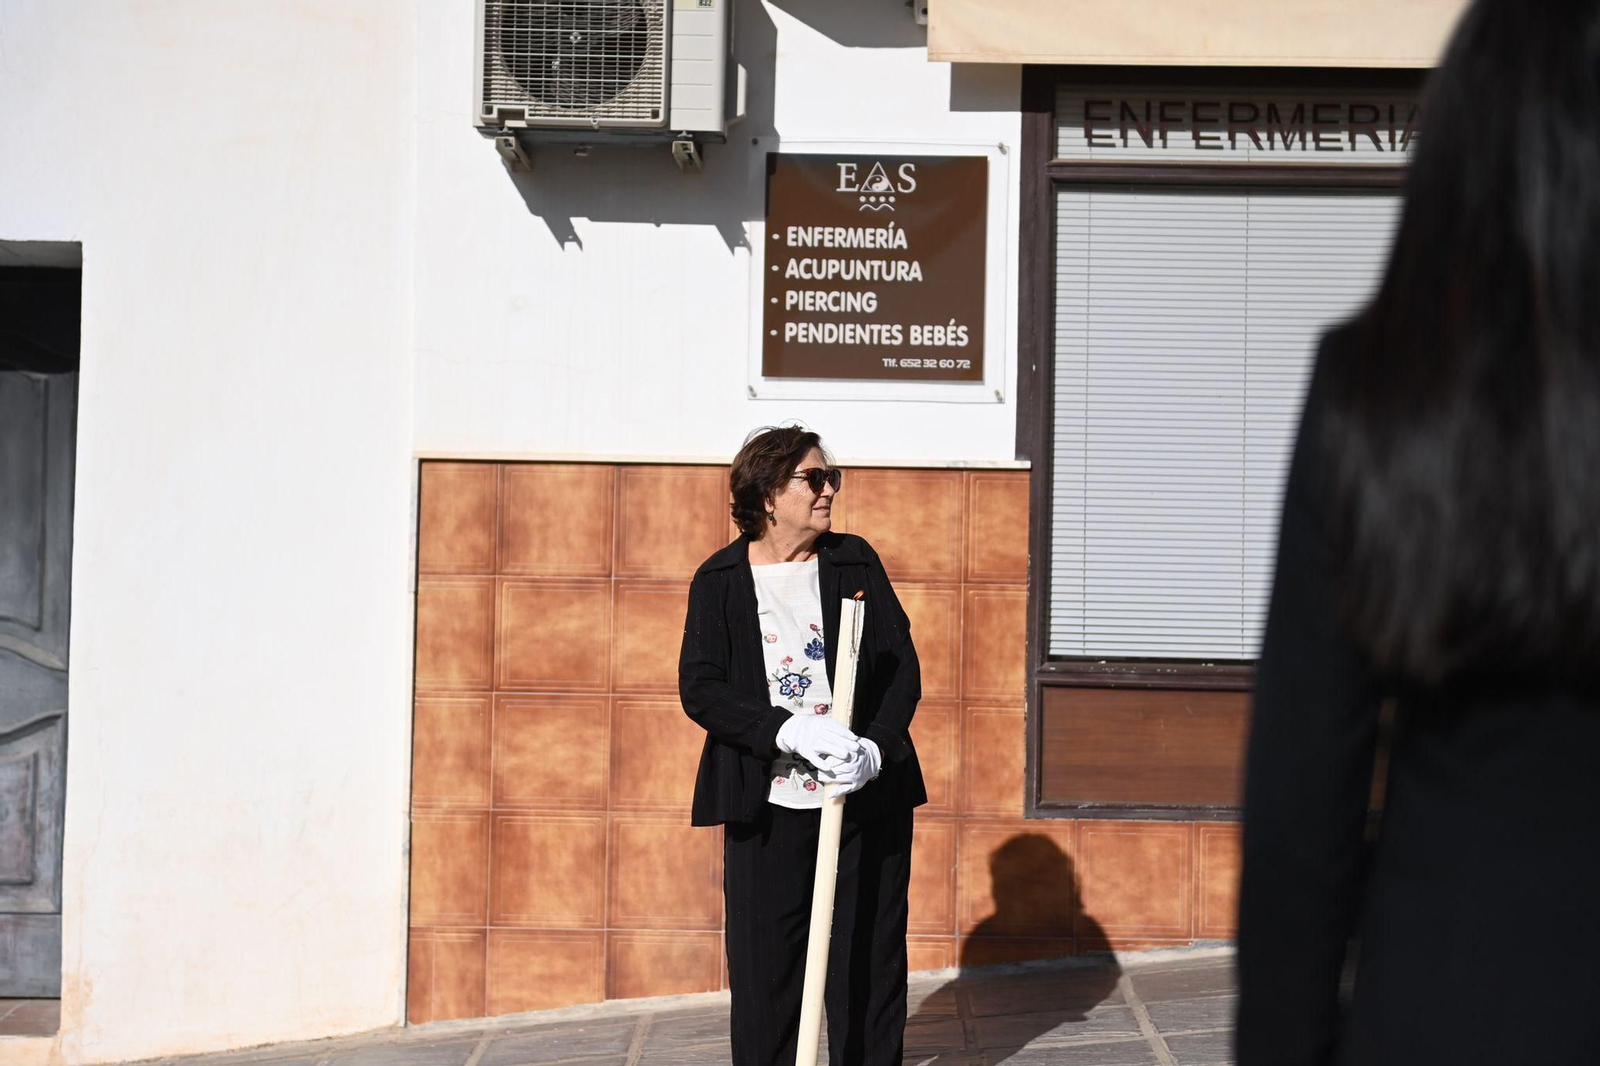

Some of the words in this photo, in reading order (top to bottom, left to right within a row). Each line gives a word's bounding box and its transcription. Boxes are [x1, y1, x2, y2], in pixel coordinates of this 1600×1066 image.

[786, 221, 908, 250] ENFERMERÍA
[784, 258, 923, 282] ACUPUNTURA
[785, 290, 878, 313] PIERCING
[784, 322, 903, 345] PENDIENTES
[909, 318, 969, 347] BEBÉS
[882, 357, 898, 368] Tlf.
[899, 358, 921, 369] 652
[922, 358, 937, 369] 32
[938, 359, 955, 369] 60
[955, 359, 971, 370] 72
